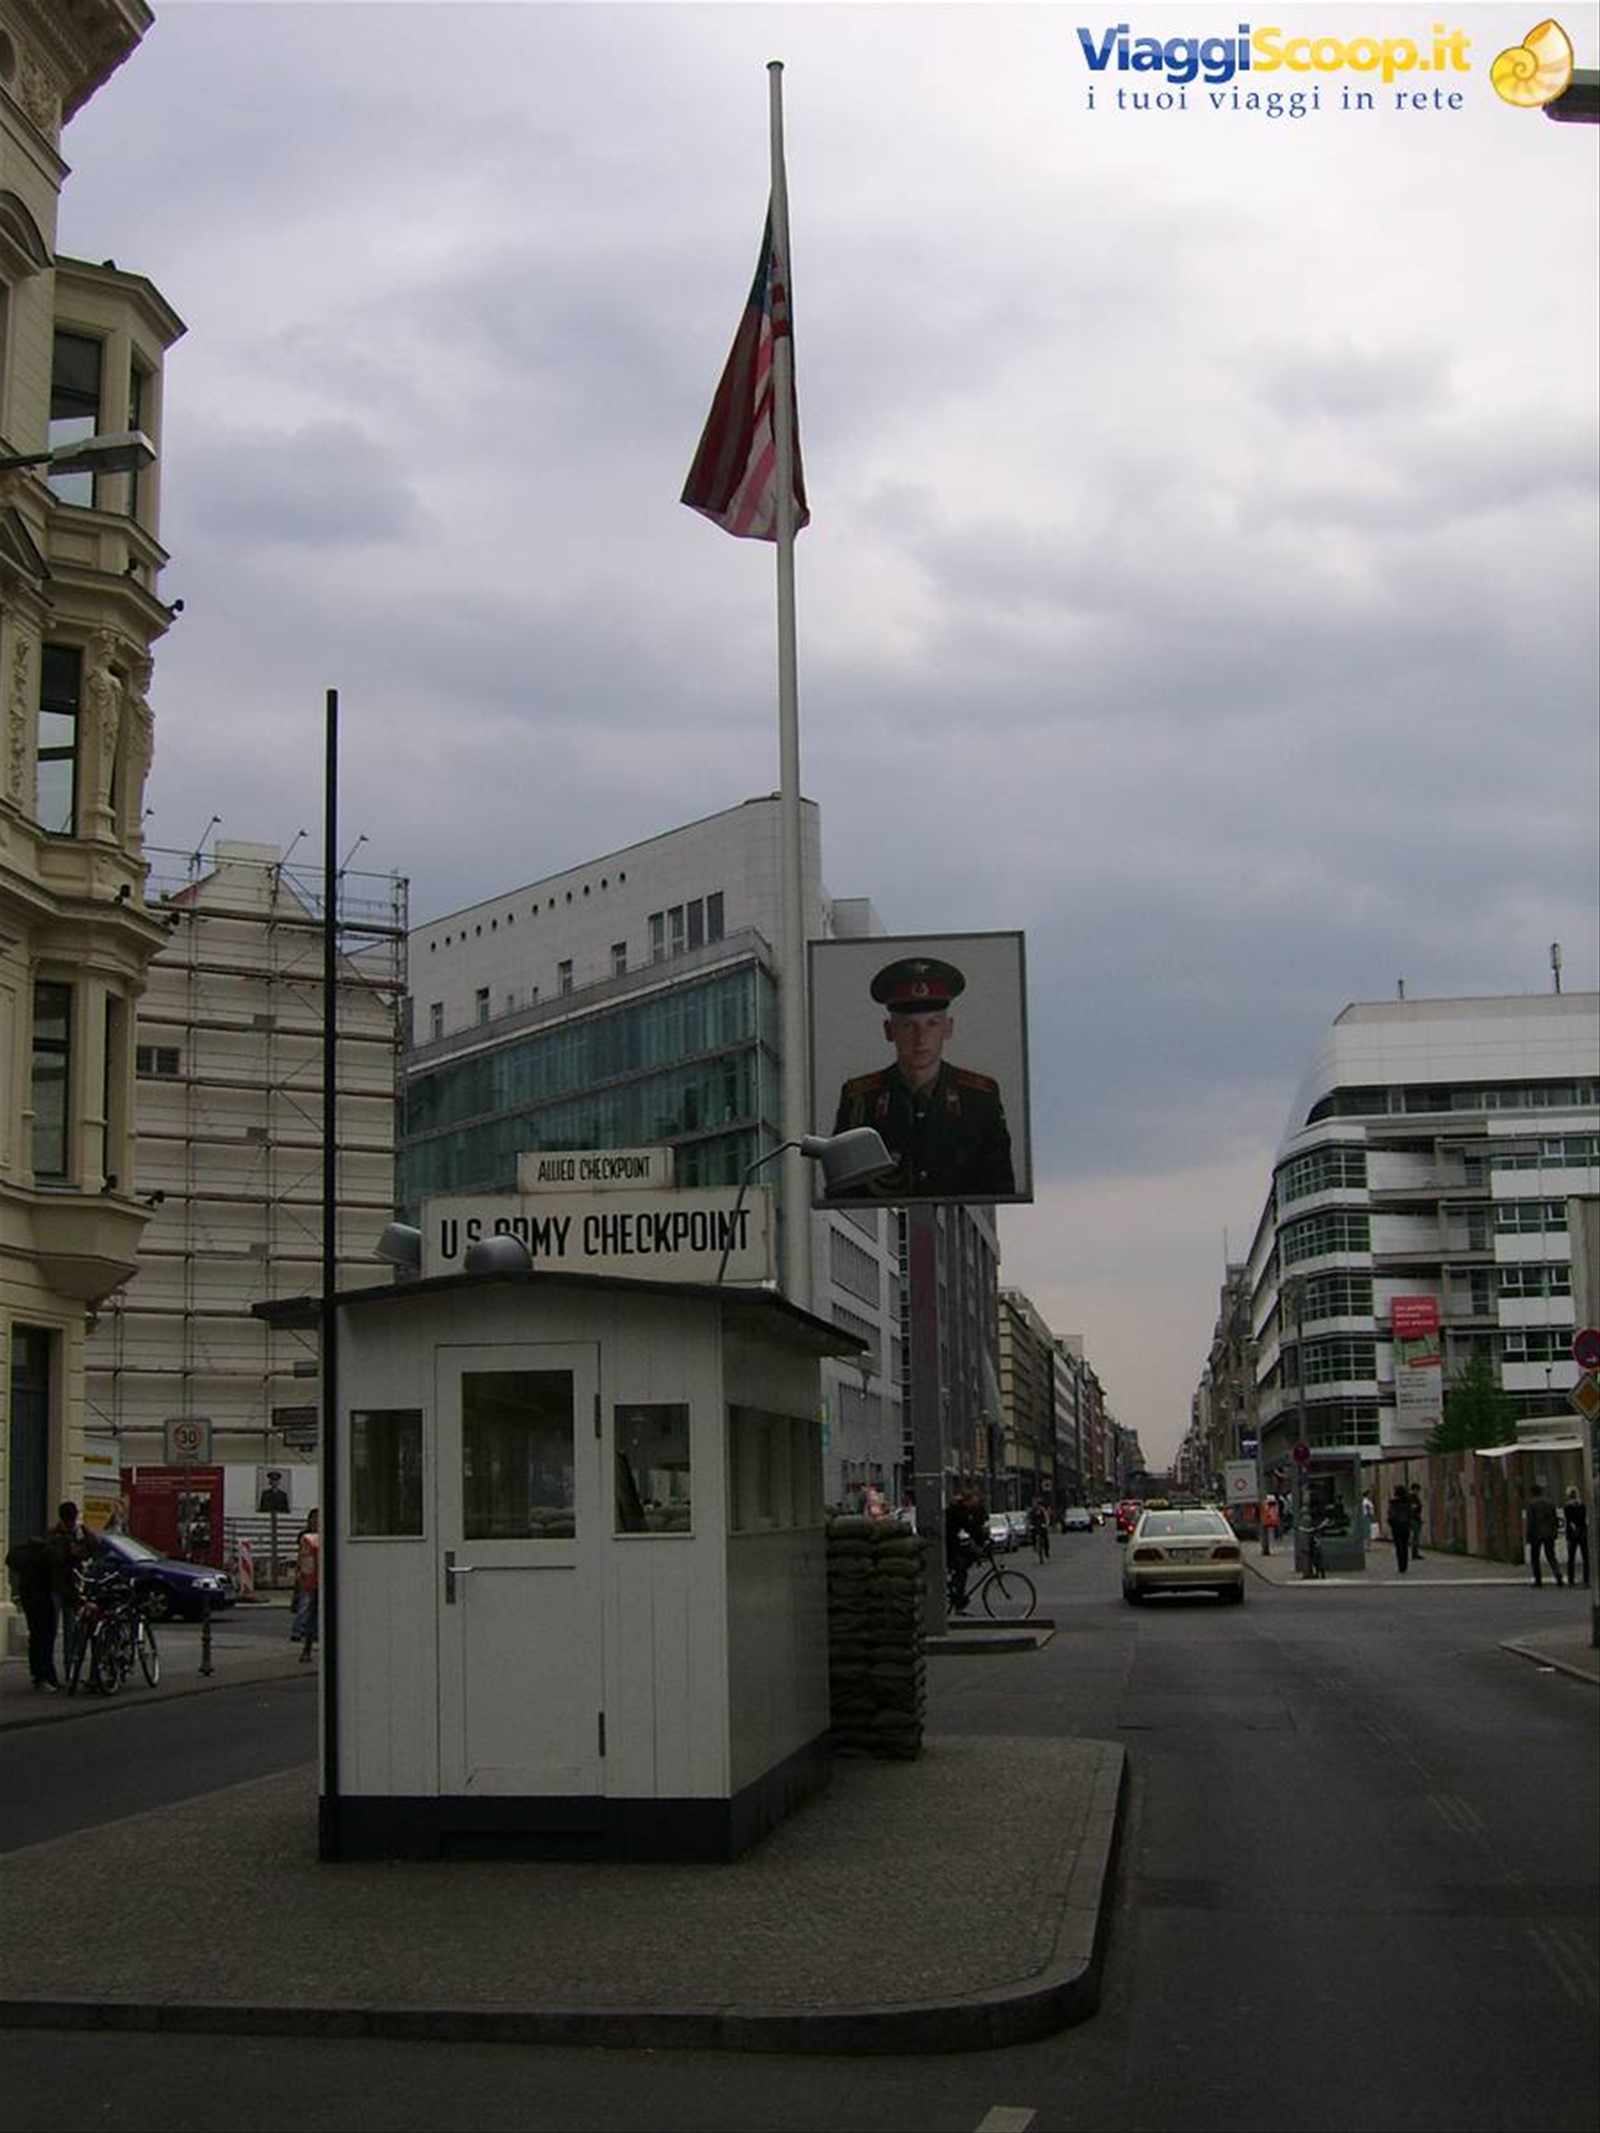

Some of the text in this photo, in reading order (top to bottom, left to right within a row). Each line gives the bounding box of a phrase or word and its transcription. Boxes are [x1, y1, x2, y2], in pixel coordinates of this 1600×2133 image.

[537, 1156, 650, 1182] ALLIED CHECKPOINT
[584, 1209, 751, 1256] CHECKPOINT
[181, 1430, 197, 1444] 30
